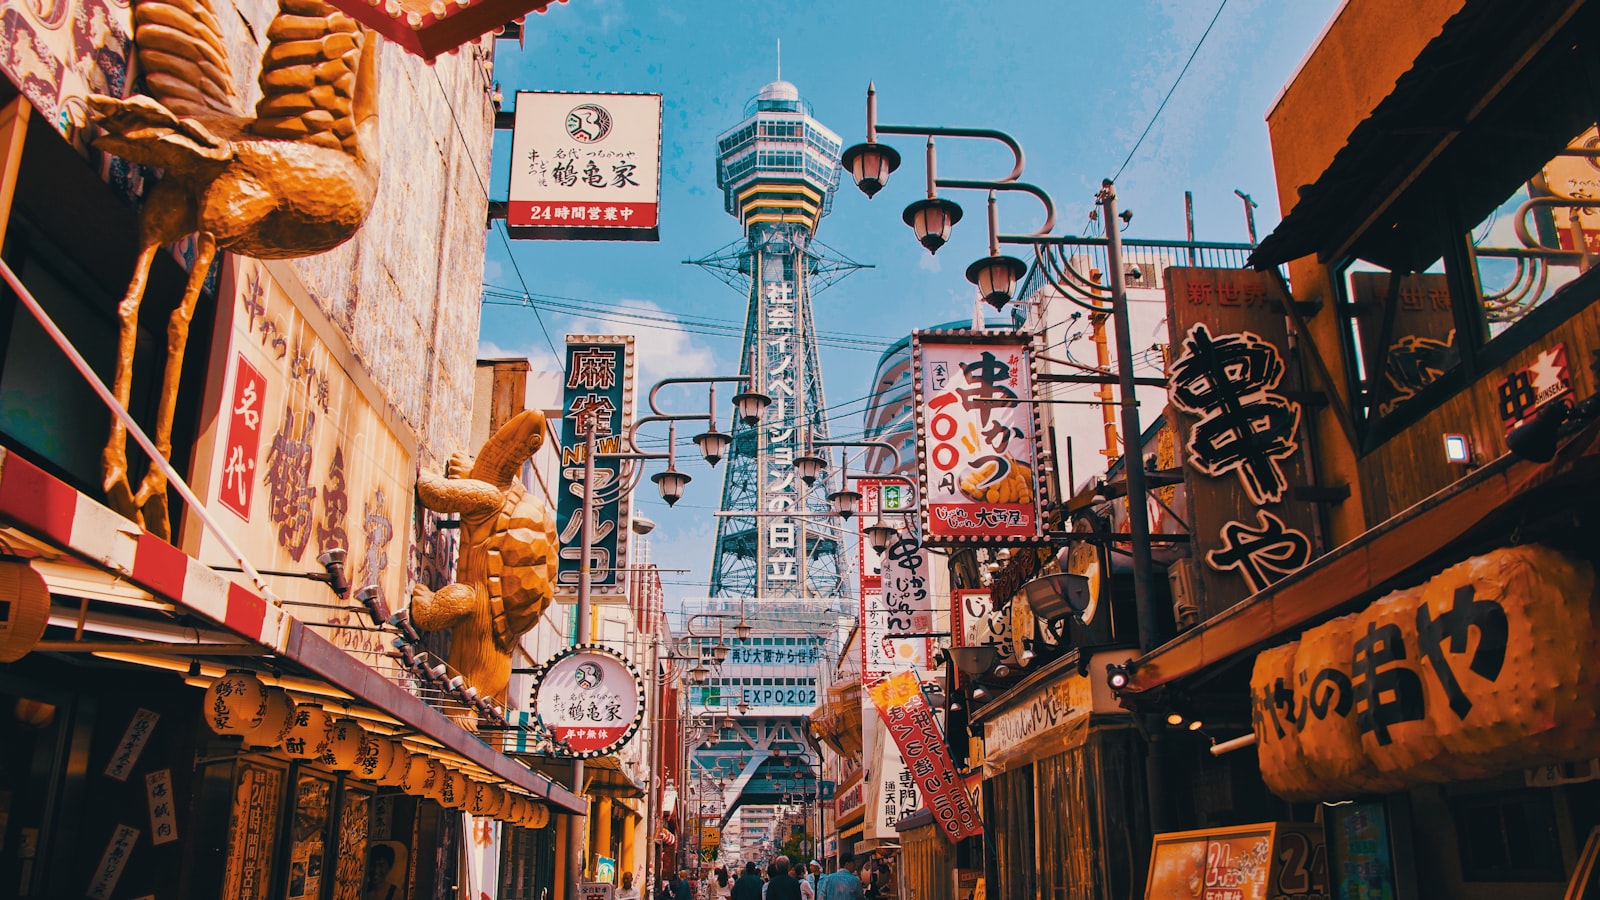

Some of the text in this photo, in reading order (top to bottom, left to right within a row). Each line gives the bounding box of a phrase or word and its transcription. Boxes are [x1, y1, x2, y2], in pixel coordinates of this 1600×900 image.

[552, 159, 641, 189] 鶴亀家
[530, 205, 635, 222] 24時間営業中
[1187, 281, 1267, 306] 新世界
[932, 364, 946, 389] 全て
[566, 347, 617, 437] 麻雀
[766, 281, 798, 581] 社会イノベーションの日立
[955, 351, 1025, 489] 串かつ
[225, 378, 260, 507] 名代
[1168, 322, 1311, 597] 串や
[213, 680, 234, 730] 鶴亀家
[568, 700, 622, 721] 鶴亀家
[744, 689, 816, 703] EXPO202
[566, 728, 609, 740] 年中無休
